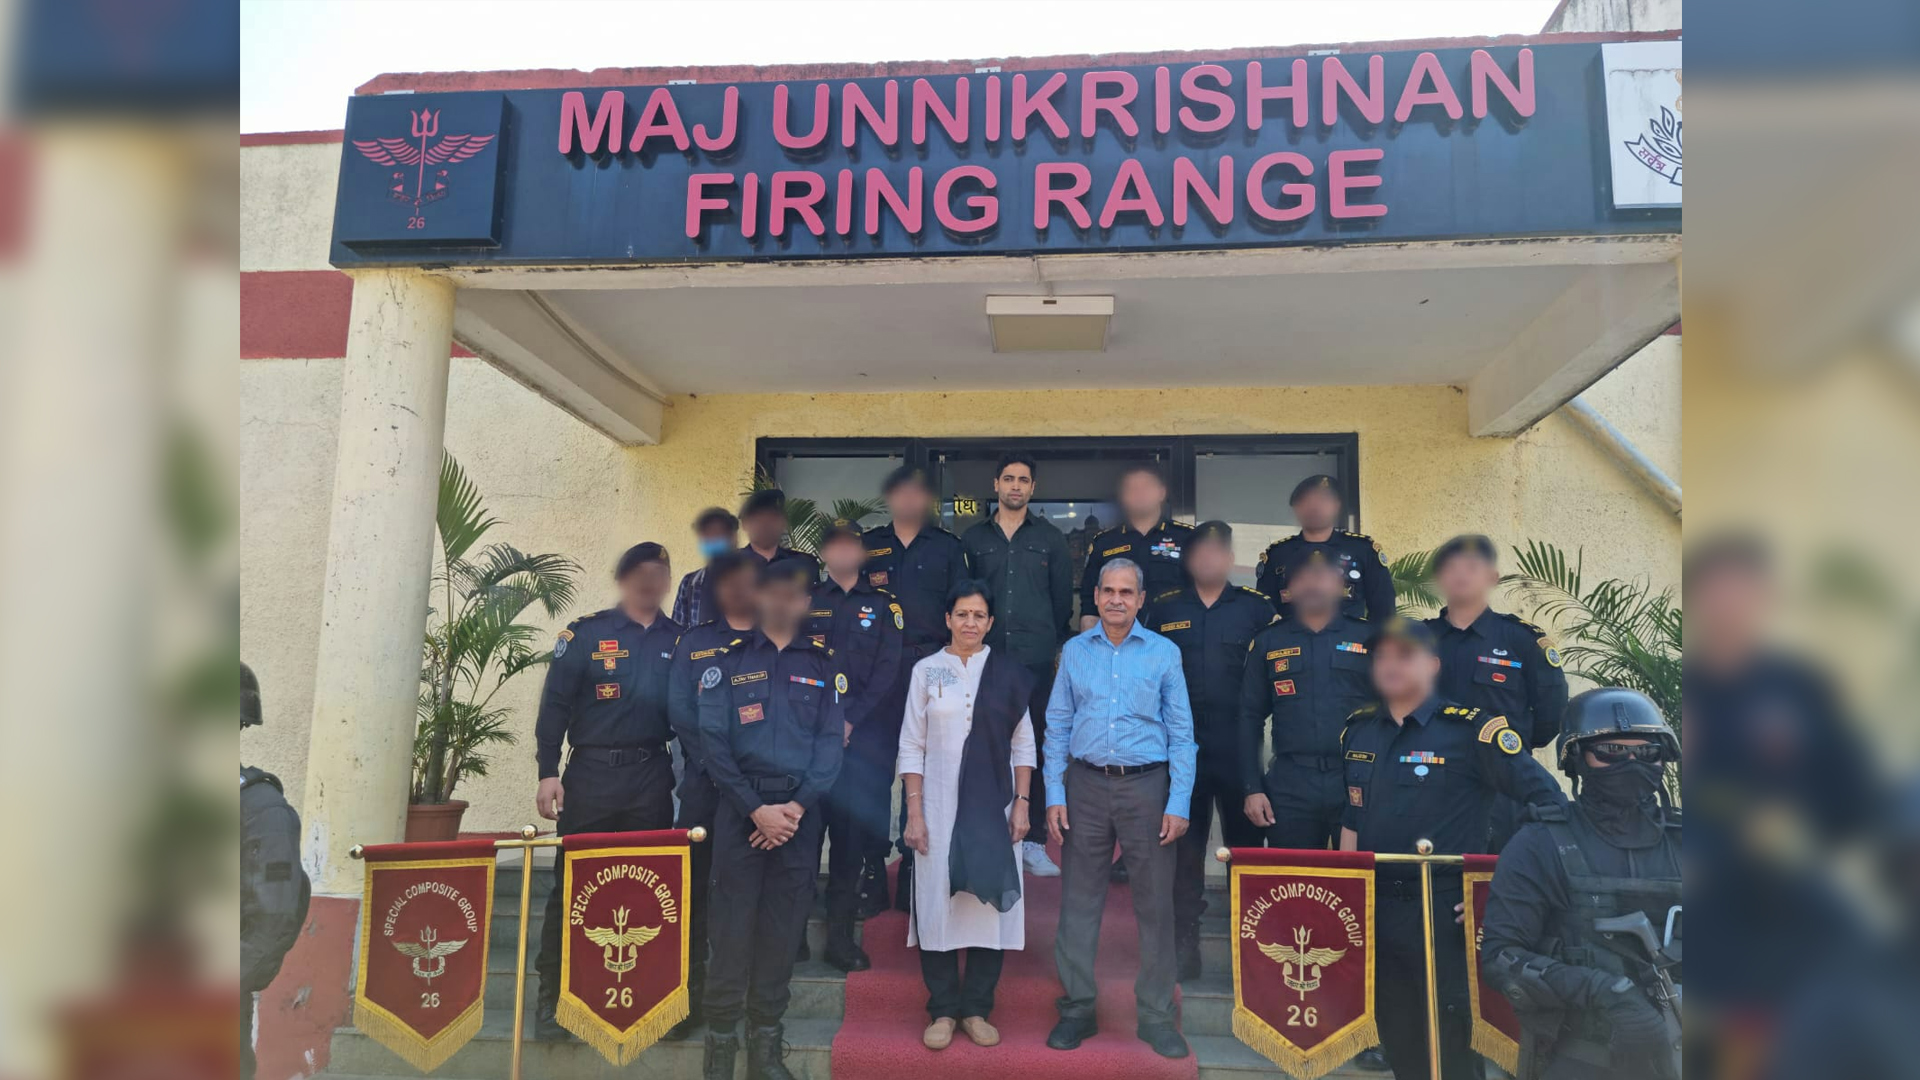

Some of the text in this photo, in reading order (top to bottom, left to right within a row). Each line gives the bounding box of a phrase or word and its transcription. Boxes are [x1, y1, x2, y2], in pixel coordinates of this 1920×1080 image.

[558, 47, 1536, 155] MAJ UNNIKRISHNAN
[685, 148, 1388, 238] FIRING RANGE
[407, 216, 426, 229] 26
[383, 881, 478, 937] SPECIAL COMPOSITE GROUP
[571, 864, 678, 926] SPECIAL COMPOSITE GROUP
[1240, 882, 1364, 948] SPECIAL COMPOSITE GROUP
[421, 992, 441, 1008] 26
[605, 987, 634, 1009] 26
[1286, 1004, 1318, 1028] 26
